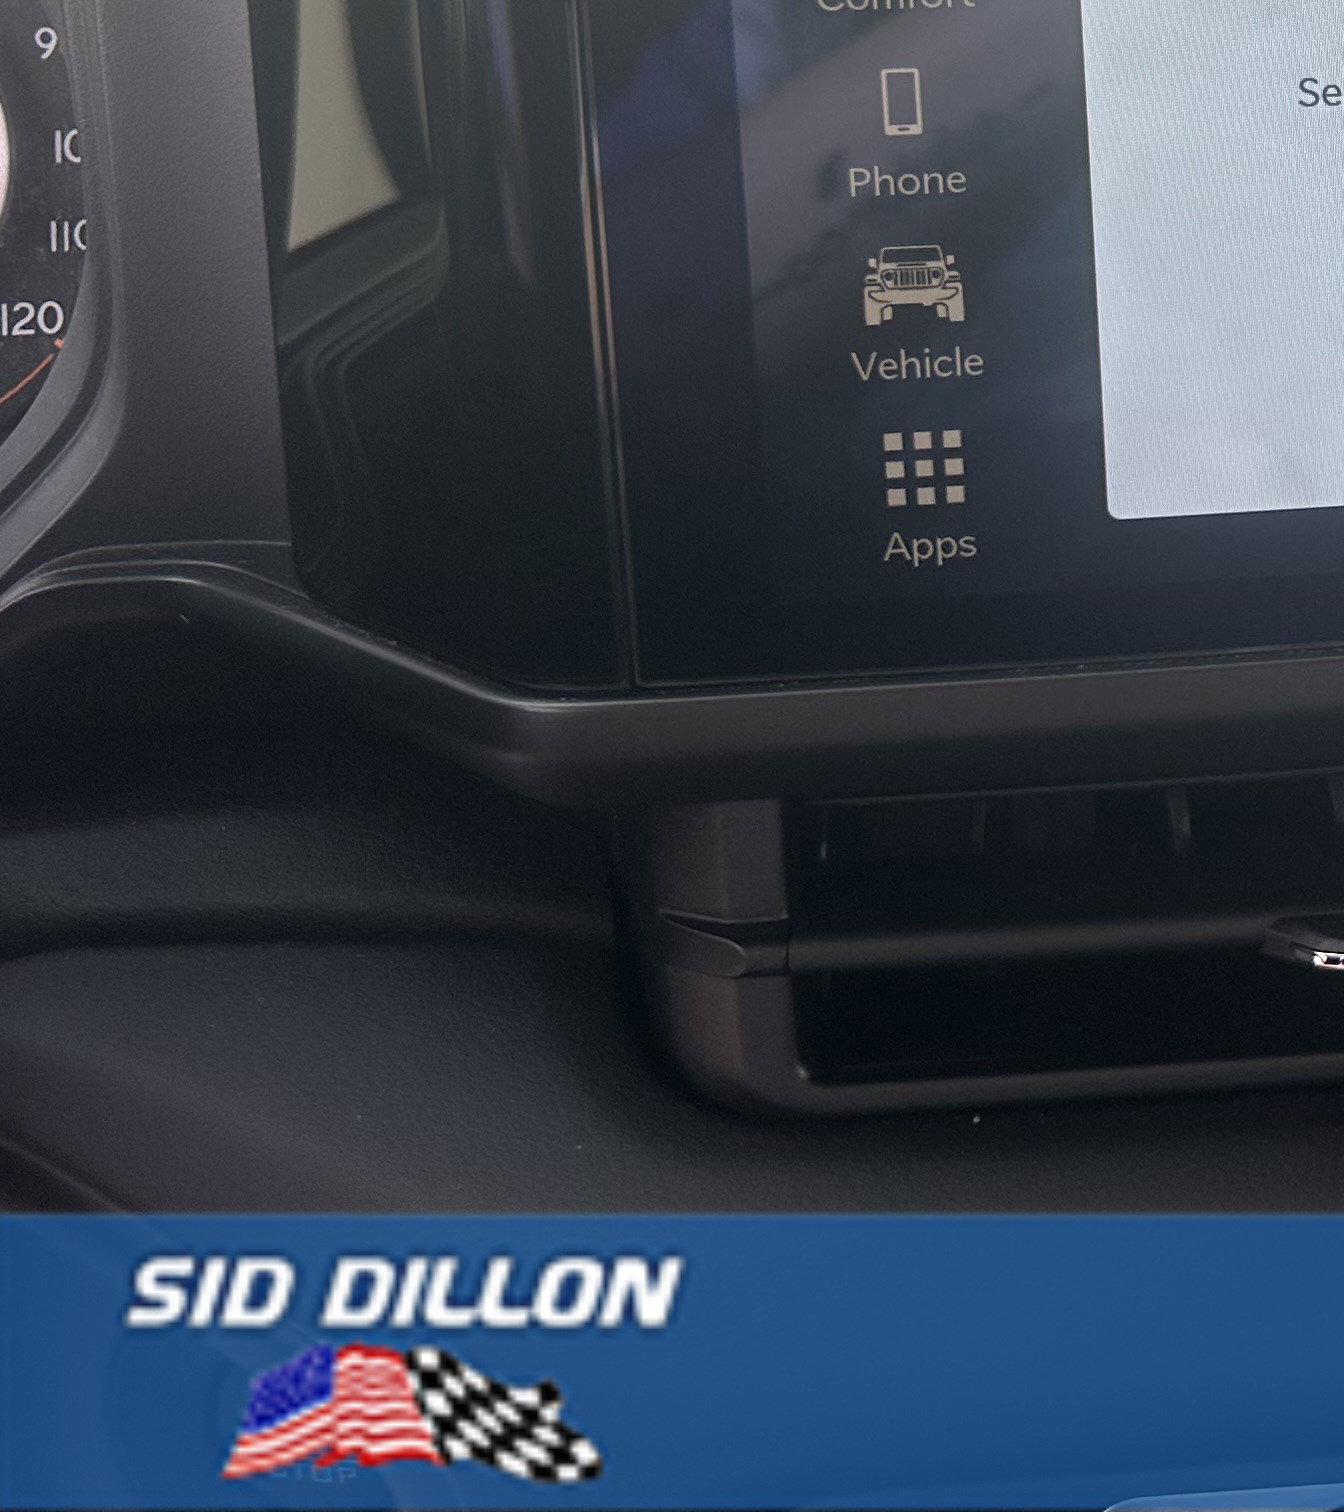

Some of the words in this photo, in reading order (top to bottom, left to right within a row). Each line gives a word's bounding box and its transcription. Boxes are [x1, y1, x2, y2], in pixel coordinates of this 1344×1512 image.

[848, 165, 968, 198] Phone
[0, 300, 64, 337] 120
[850, 345, 985, 382] Vehicle
[883, 531, 978, 567] Apps
